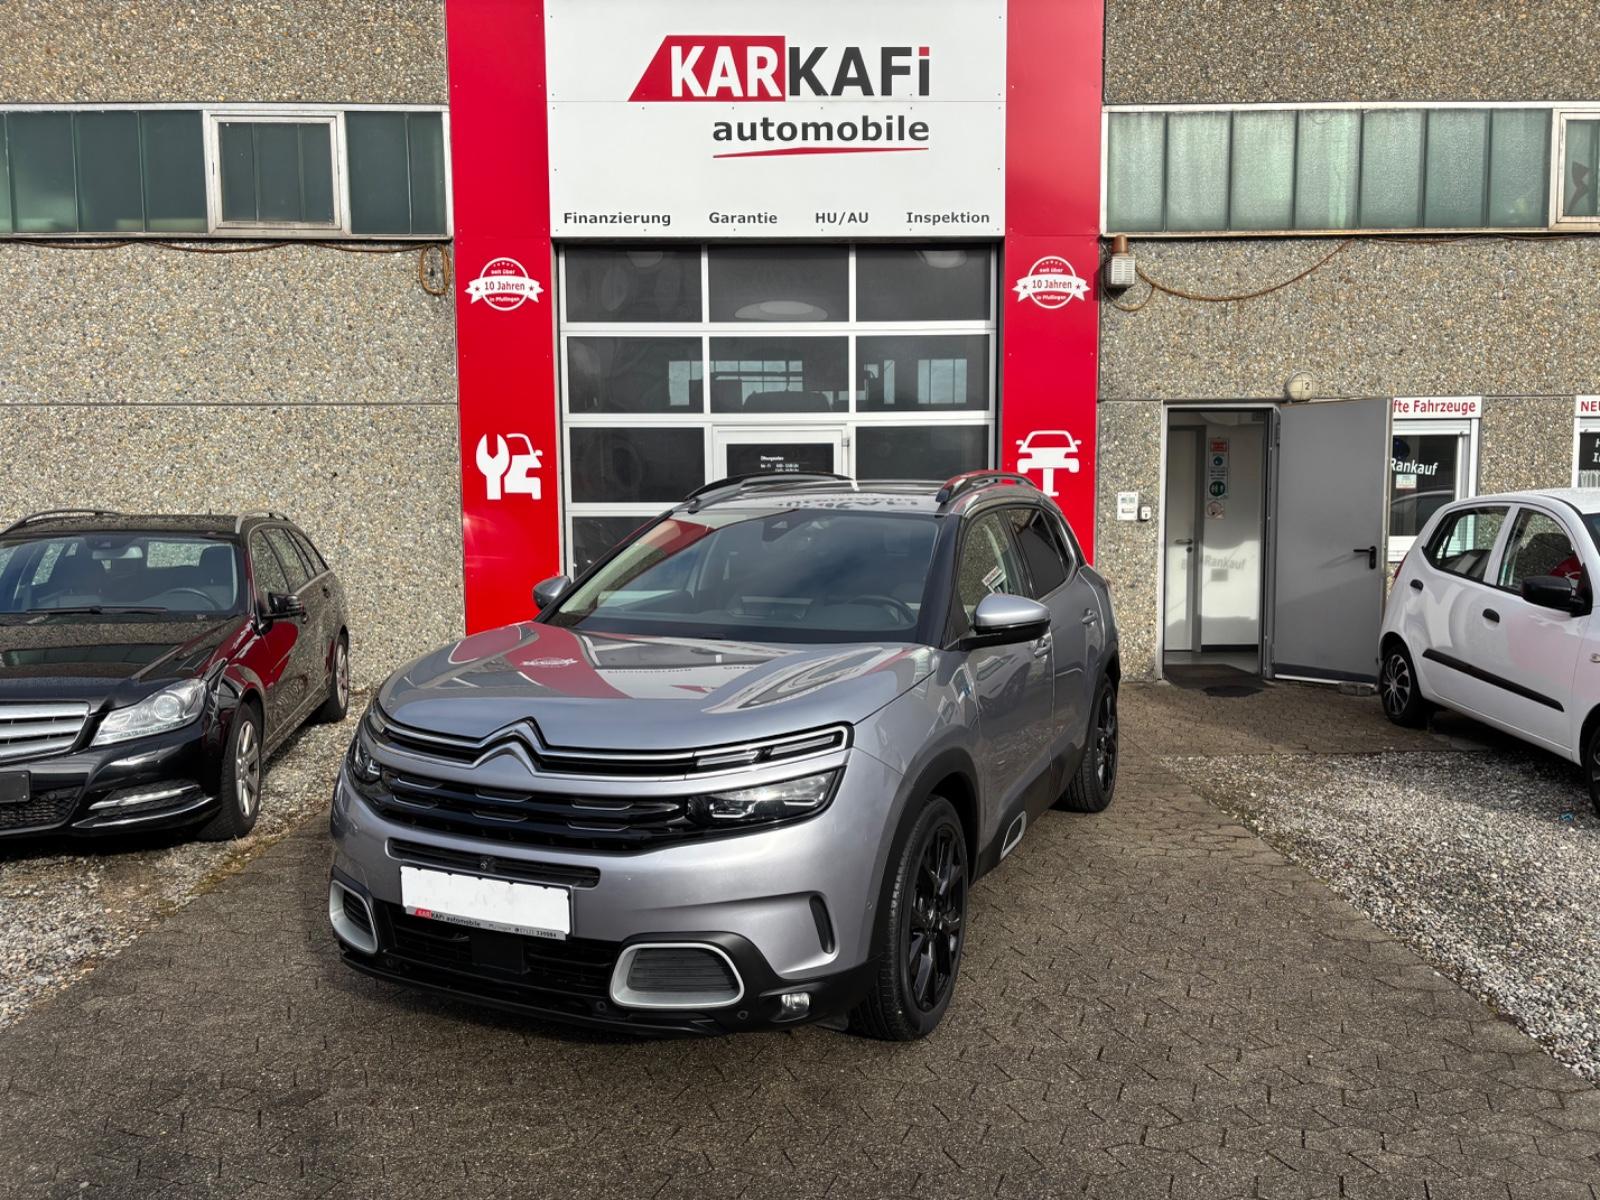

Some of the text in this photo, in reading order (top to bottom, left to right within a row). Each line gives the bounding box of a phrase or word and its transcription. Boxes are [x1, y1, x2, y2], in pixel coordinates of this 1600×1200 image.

[712, 116, 929, 142] automobile
[563, 211, 671, 227] Finanzierung
[709, 212, 778, 224] Garantie
[815, 211, 869, 225] HU/AU
[906, 211, 990, 226] Inspektion
[485, 281, 525, 290] 10 Jahren
[1032, 280, 1072, 288] 10 Jahren
[1413, 400, 1476, 415] Fahrzeuge
[1581, 401, 1600, 412] NE
